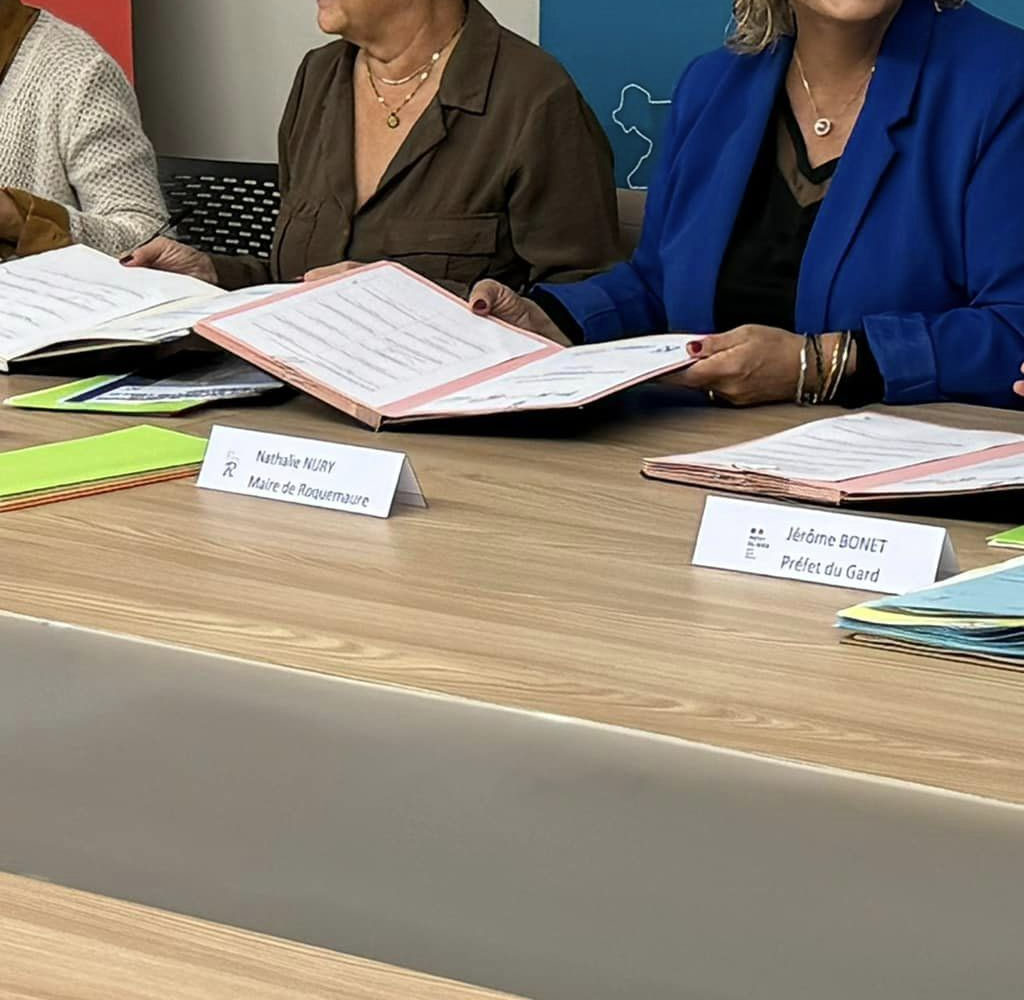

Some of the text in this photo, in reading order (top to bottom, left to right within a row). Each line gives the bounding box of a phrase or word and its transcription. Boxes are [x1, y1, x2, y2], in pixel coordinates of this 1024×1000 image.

[255, 450, 336, 475] Nathalie NURY
[248, 475, 370, 507] Maire de Roquemaure
[786, 526, 836, 548] Jérôme
[839, 533, 888, 554] BONET
[780, 555, 881, 583] Préfet du Gard
